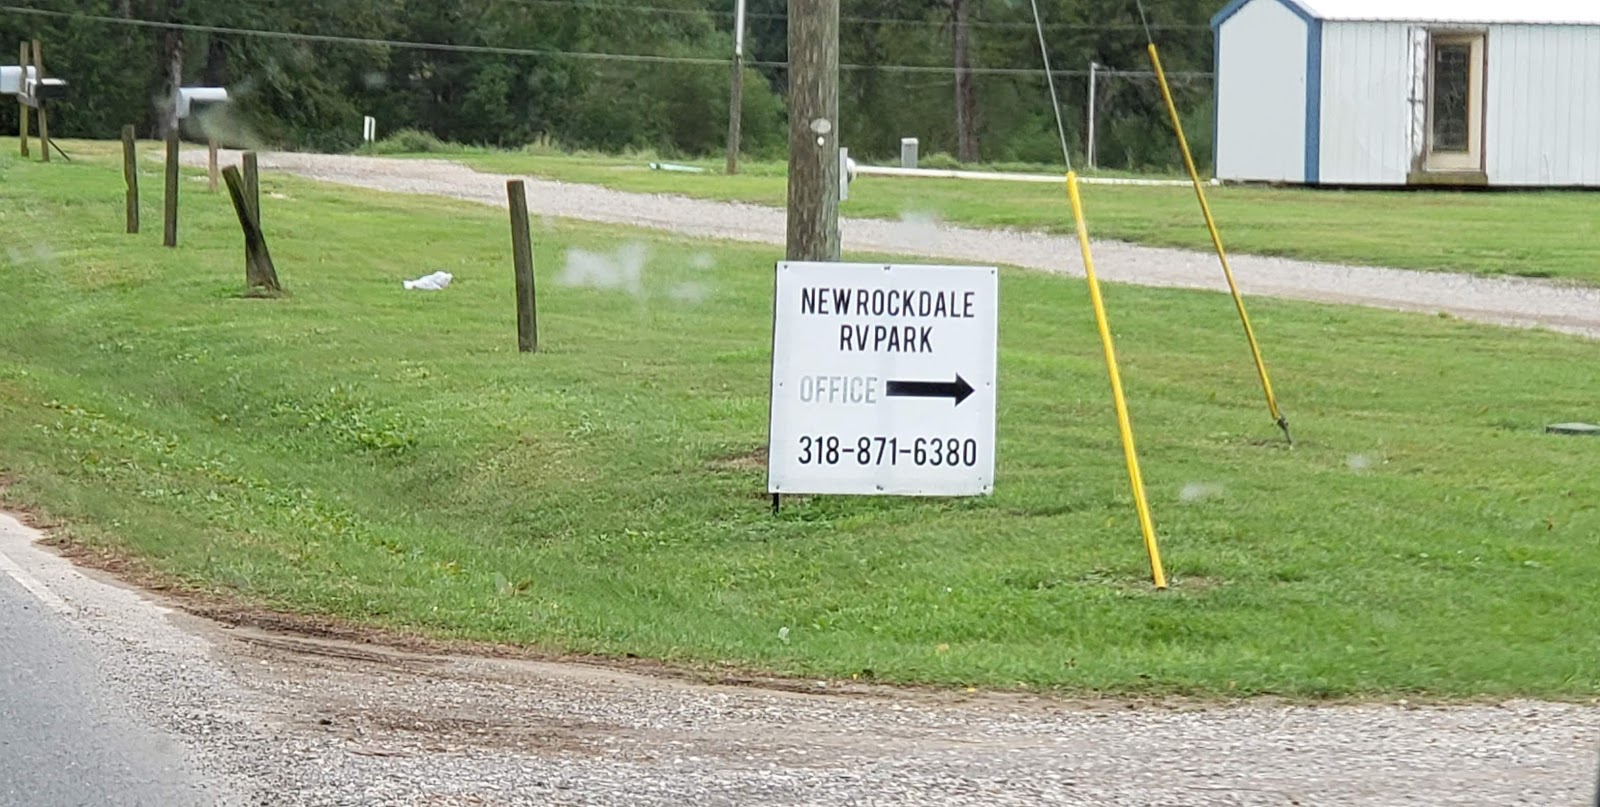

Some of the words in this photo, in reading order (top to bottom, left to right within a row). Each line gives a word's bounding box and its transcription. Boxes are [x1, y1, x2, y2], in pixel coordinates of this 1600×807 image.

[801, 287, 852, 315] NEW
[857, 289, 975, 318] ROCKDALE
[840, 324, 869, 351] RV
[874, 326, 933, 353] PARK
[799, 375, 877, 404] OFFICE
[798, 435, 977, 467] 318-871-6380
